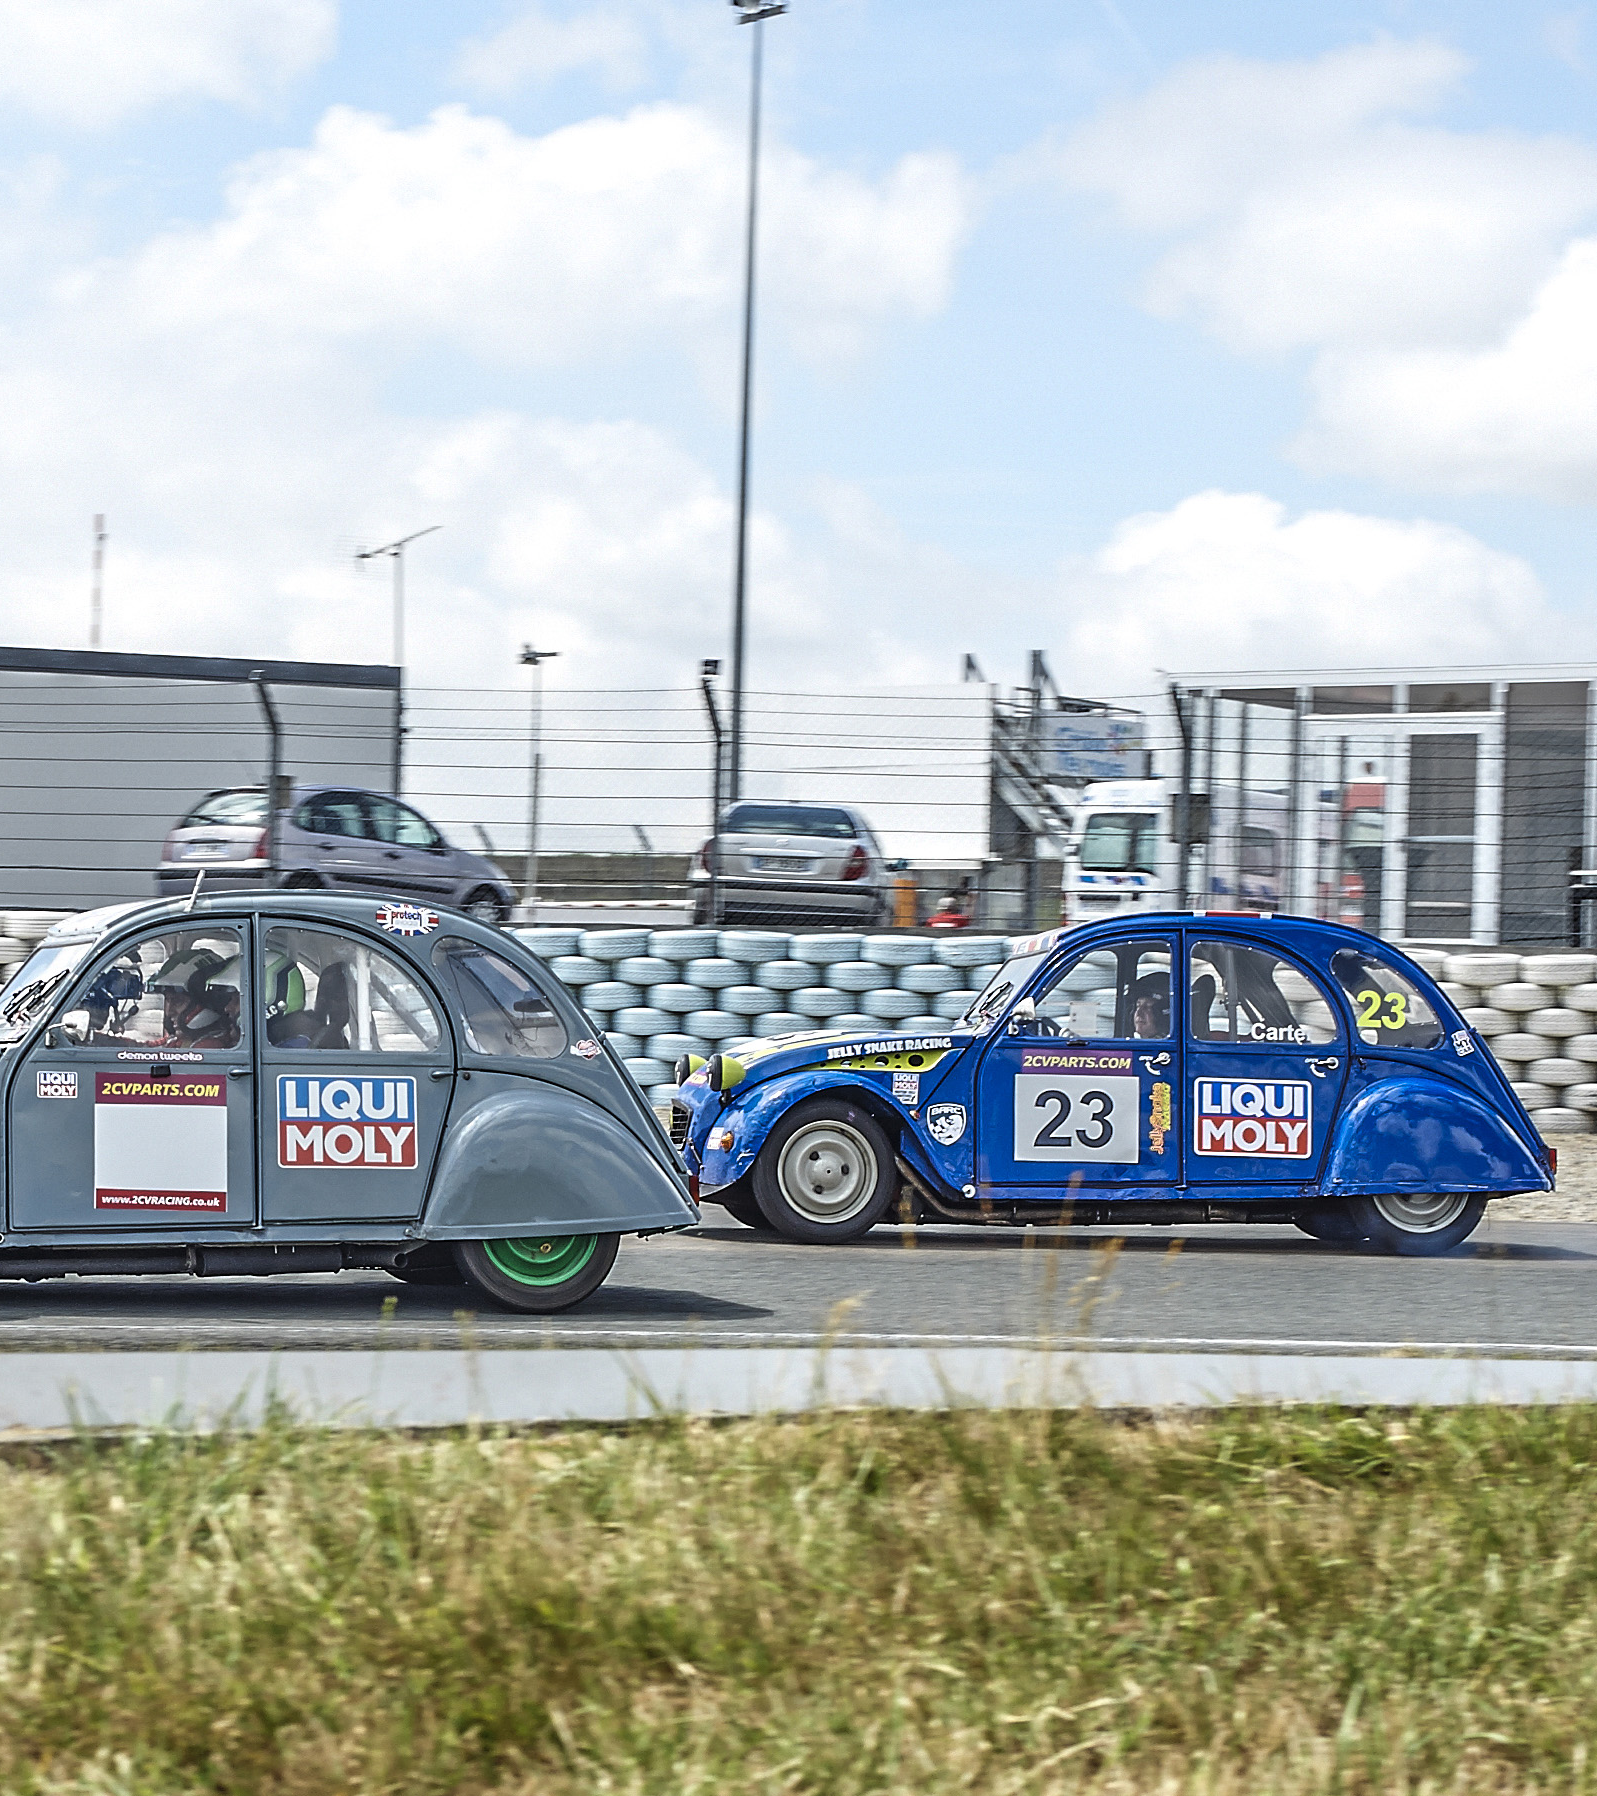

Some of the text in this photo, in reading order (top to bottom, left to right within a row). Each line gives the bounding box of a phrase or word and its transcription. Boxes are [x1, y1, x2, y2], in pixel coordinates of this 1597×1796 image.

[1357, 990, 1407, 1029] 23
[117, 1051, 158, 1061] demon
[827, 1038, 951, 1059] JELLY SNAKE RACING
[1023, 1055, 1131, 1070] 2CVPARTS.COM
[39, 1073, 75, 1085] LIQUI
[39, 1085, 77, 1096] MOLY
[101, 1082, 220, 1097] 2CVPARTS.COM
[285, 1080, 409, 1122] LIQUI
[1202, 1083, 1304, 1117] LIQUI
[931, 1106, 962, 1116] BARC
[1033, 1089, 1114, 1149] 23
[286, 1124, 414, 1164] MOLY
[1201, 1119, 1307, 1152] MOLY
[101, 1195, 220, 1207] www.2CVRACING.co.uk
